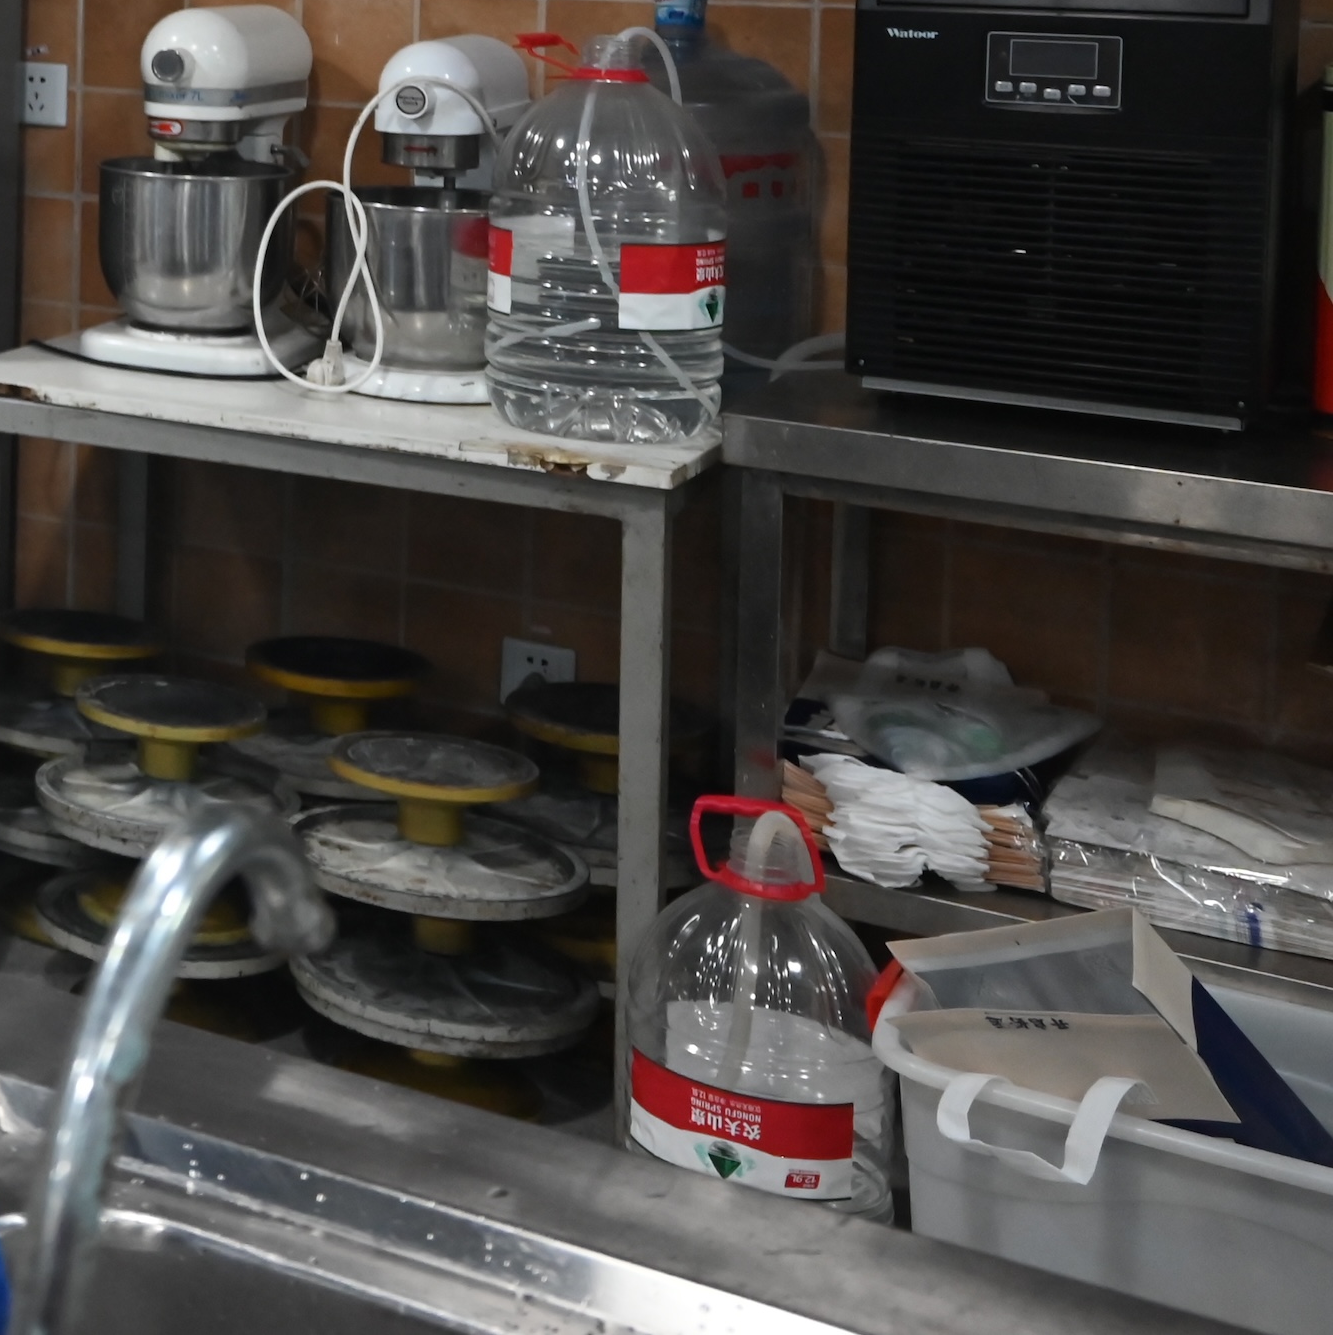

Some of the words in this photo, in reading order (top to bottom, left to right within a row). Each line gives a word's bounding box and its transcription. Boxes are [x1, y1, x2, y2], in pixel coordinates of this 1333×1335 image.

[690, 1096, 722, 1114] SPRING
[691, 1106, 761, 1140] 农夫山泉
[724, 1107, 761, 1123] NONGFU
